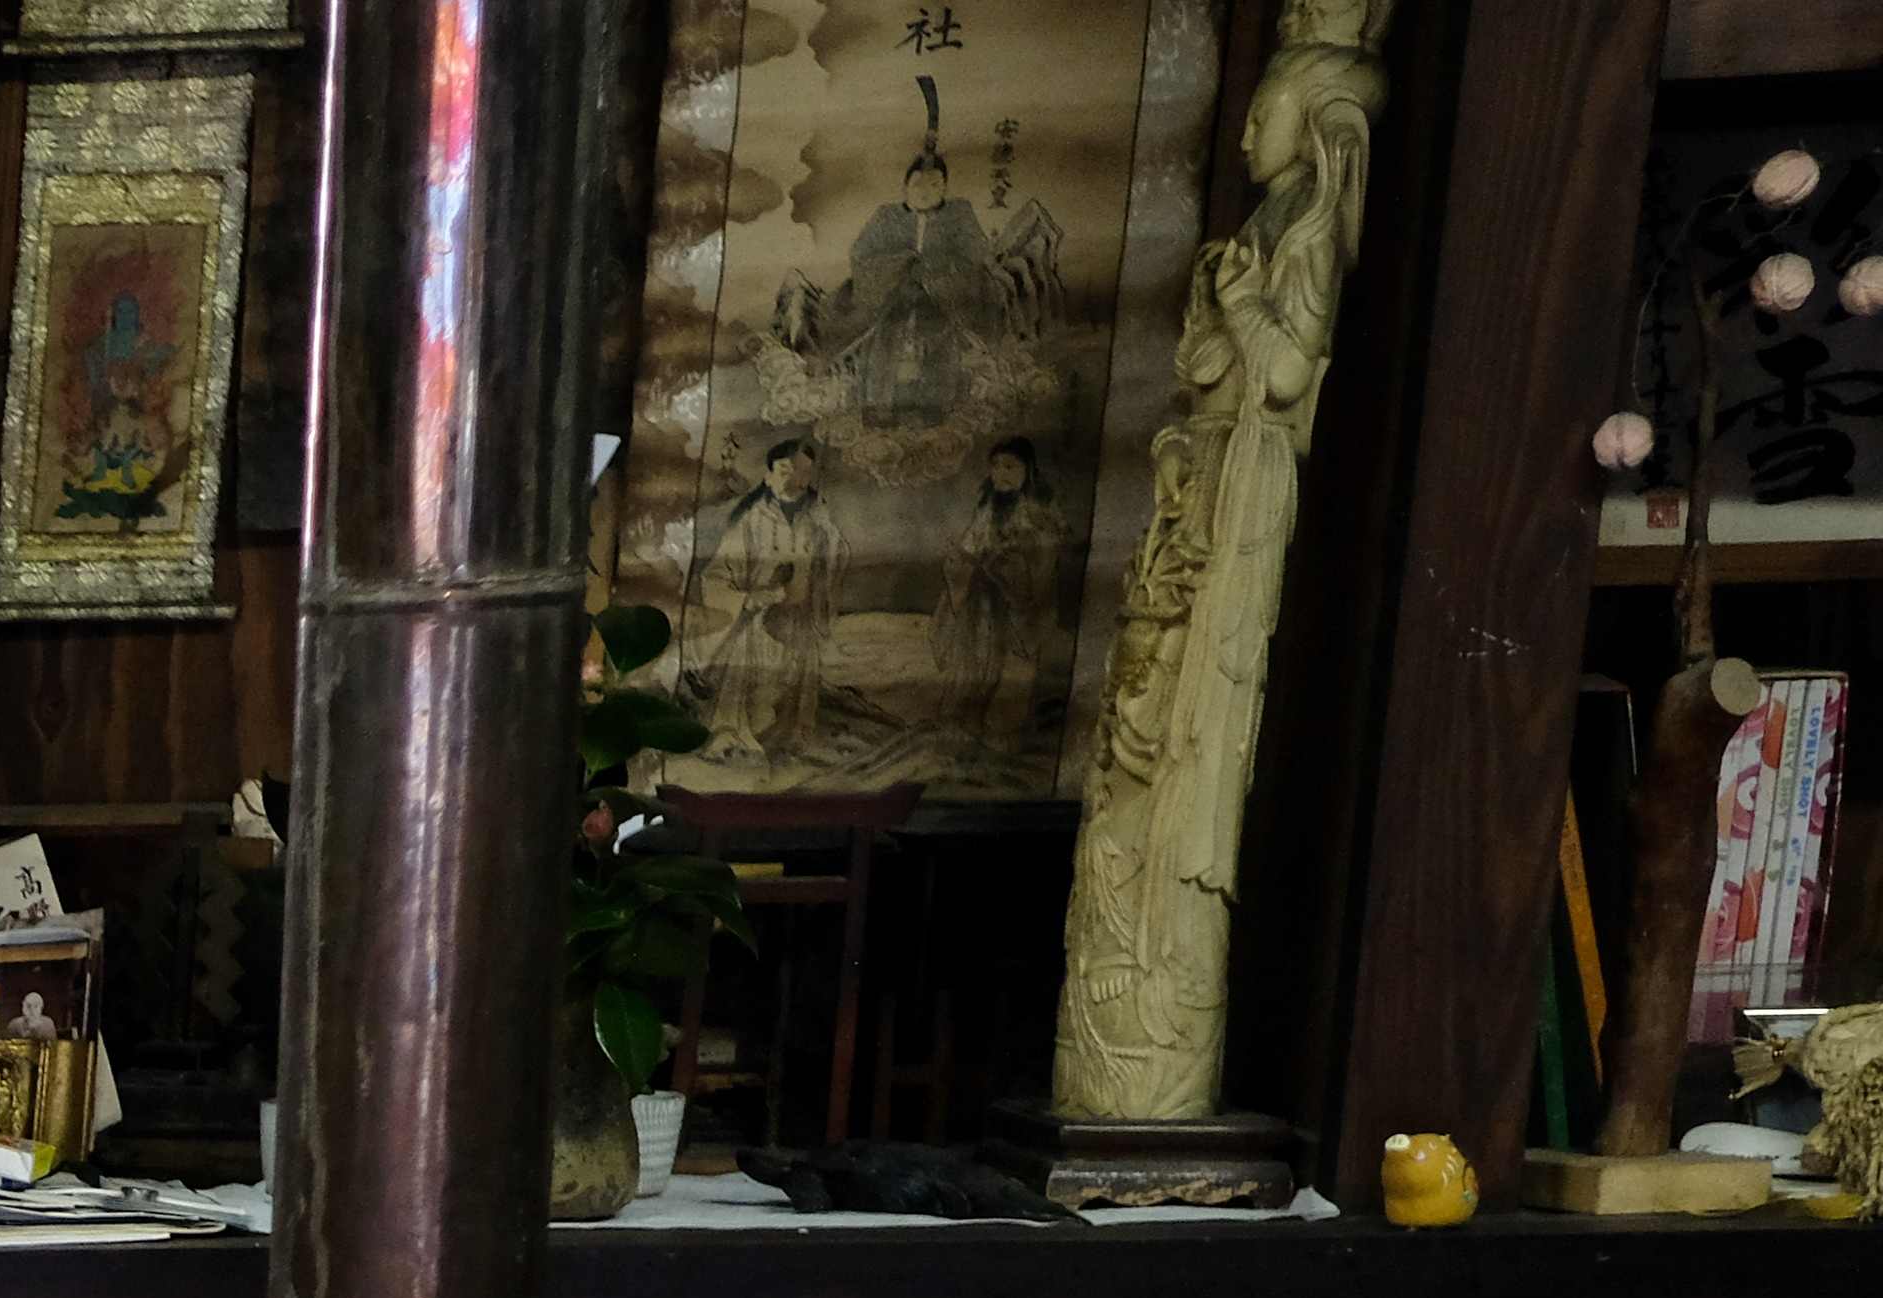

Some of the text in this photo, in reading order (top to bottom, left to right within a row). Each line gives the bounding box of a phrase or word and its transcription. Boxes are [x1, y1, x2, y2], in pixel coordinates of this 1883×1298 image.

[895, 7, 963, 54] 社
[1785, 707, 1802, 769] LOVELY
[1797, 705, 1820, 818] LOVELY SHOT
